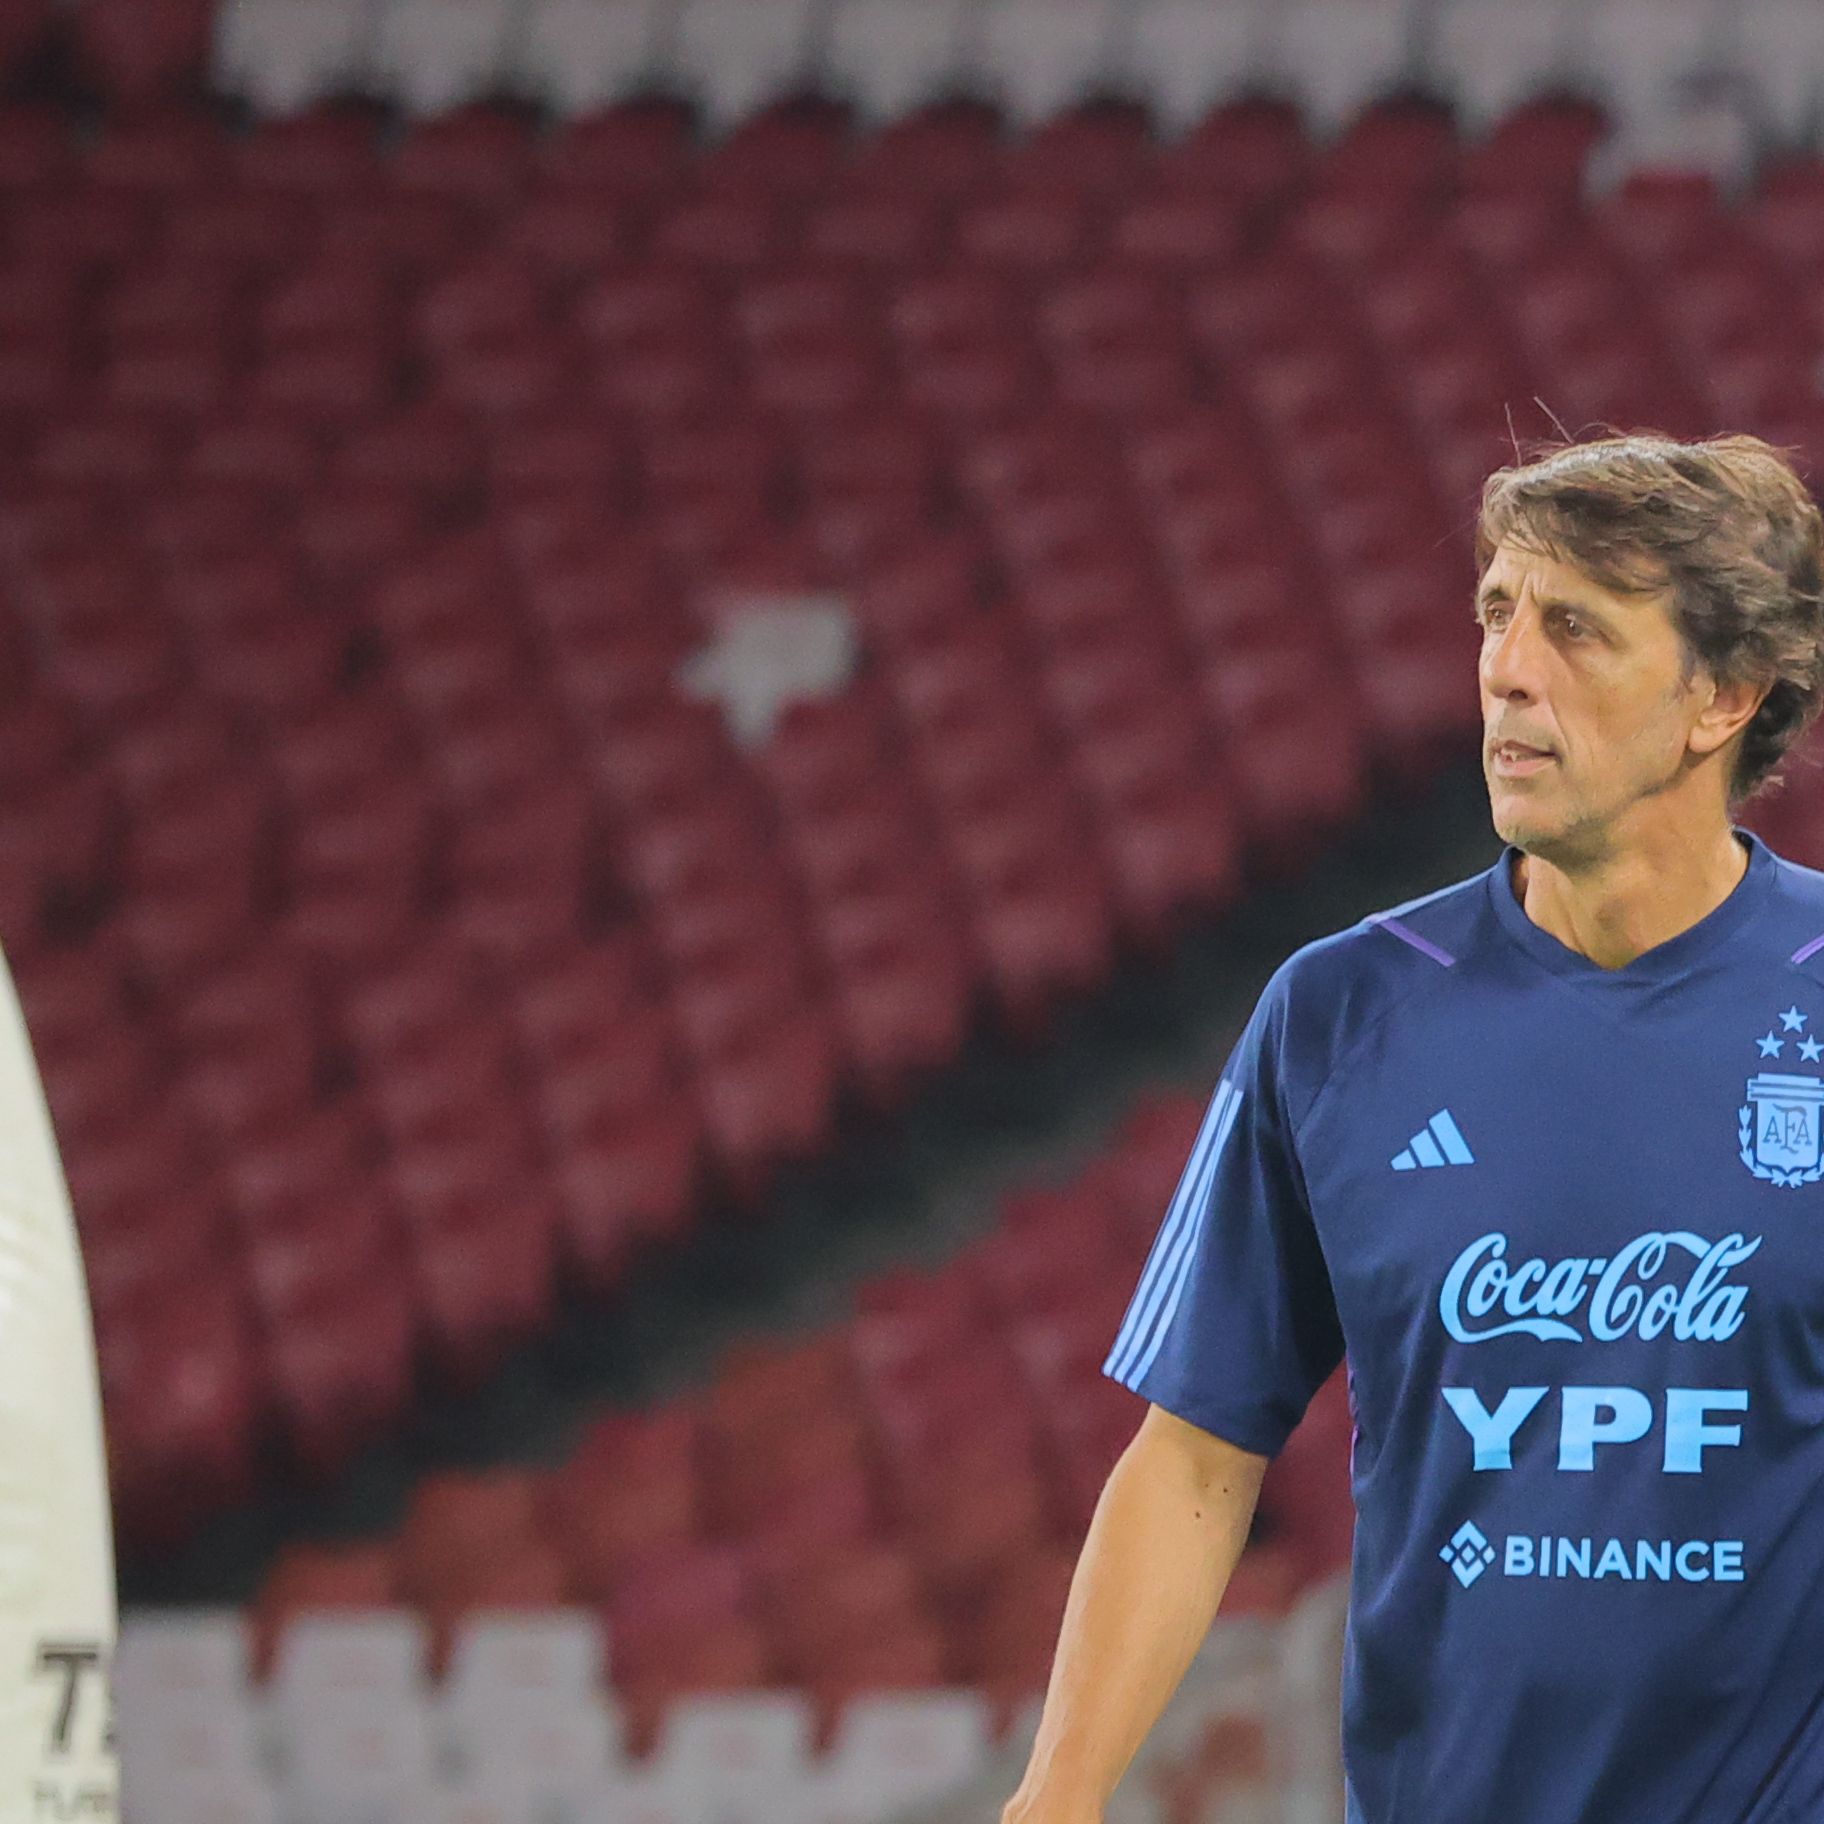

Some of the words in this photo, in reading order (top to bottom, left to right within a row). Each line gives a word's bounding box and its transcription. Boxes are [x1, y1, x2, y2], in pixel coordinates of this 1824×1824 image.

[1761, 1102, 1813, 1154] AFA
[1439, 1231, 1763, 1344] Coca-Cola
[1440, 1386, 1749, 1473] YPF
[1503, 1535, 1745, 1582] BINANCE
